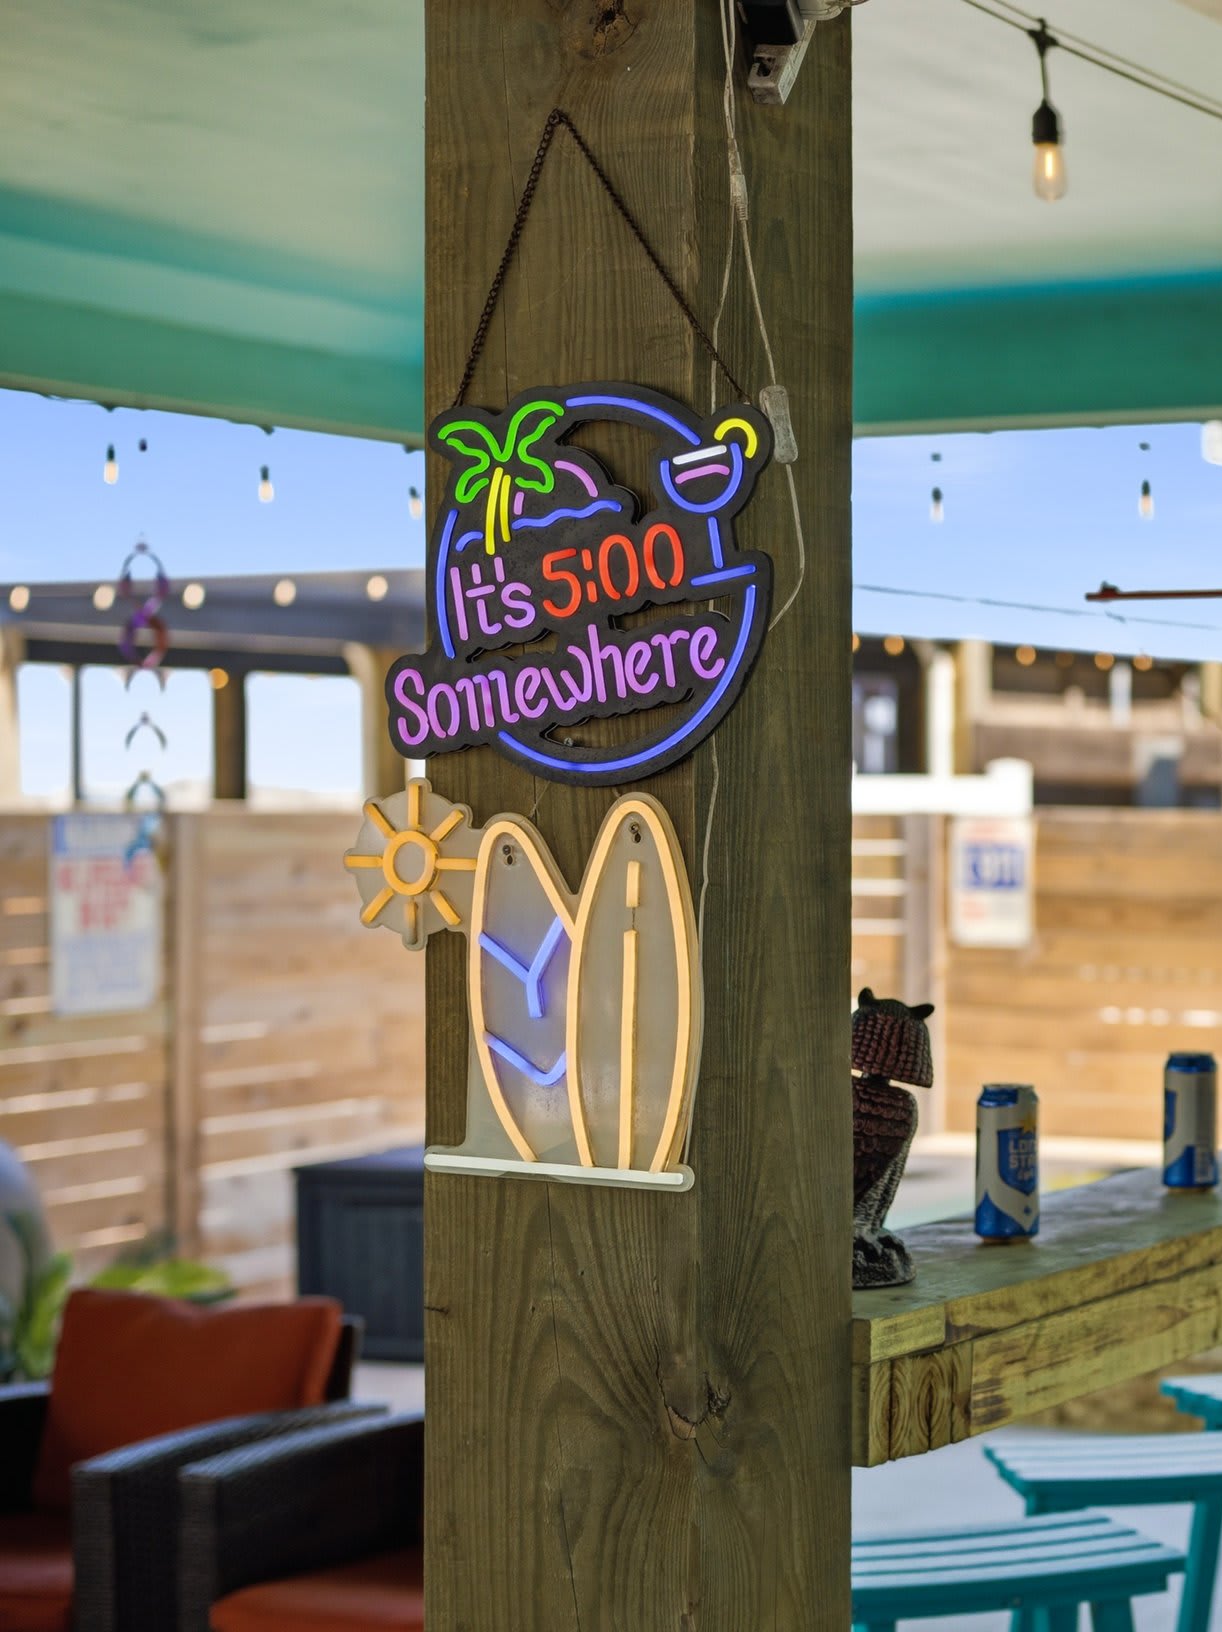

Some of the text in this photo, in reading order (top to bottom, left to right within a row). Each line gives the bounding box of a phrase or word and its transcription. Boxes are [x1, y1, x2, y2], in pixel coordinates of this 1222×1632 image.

[450, 523, 685, 641] It's 5:00
[394, 624, 726, 746] Somewhere
